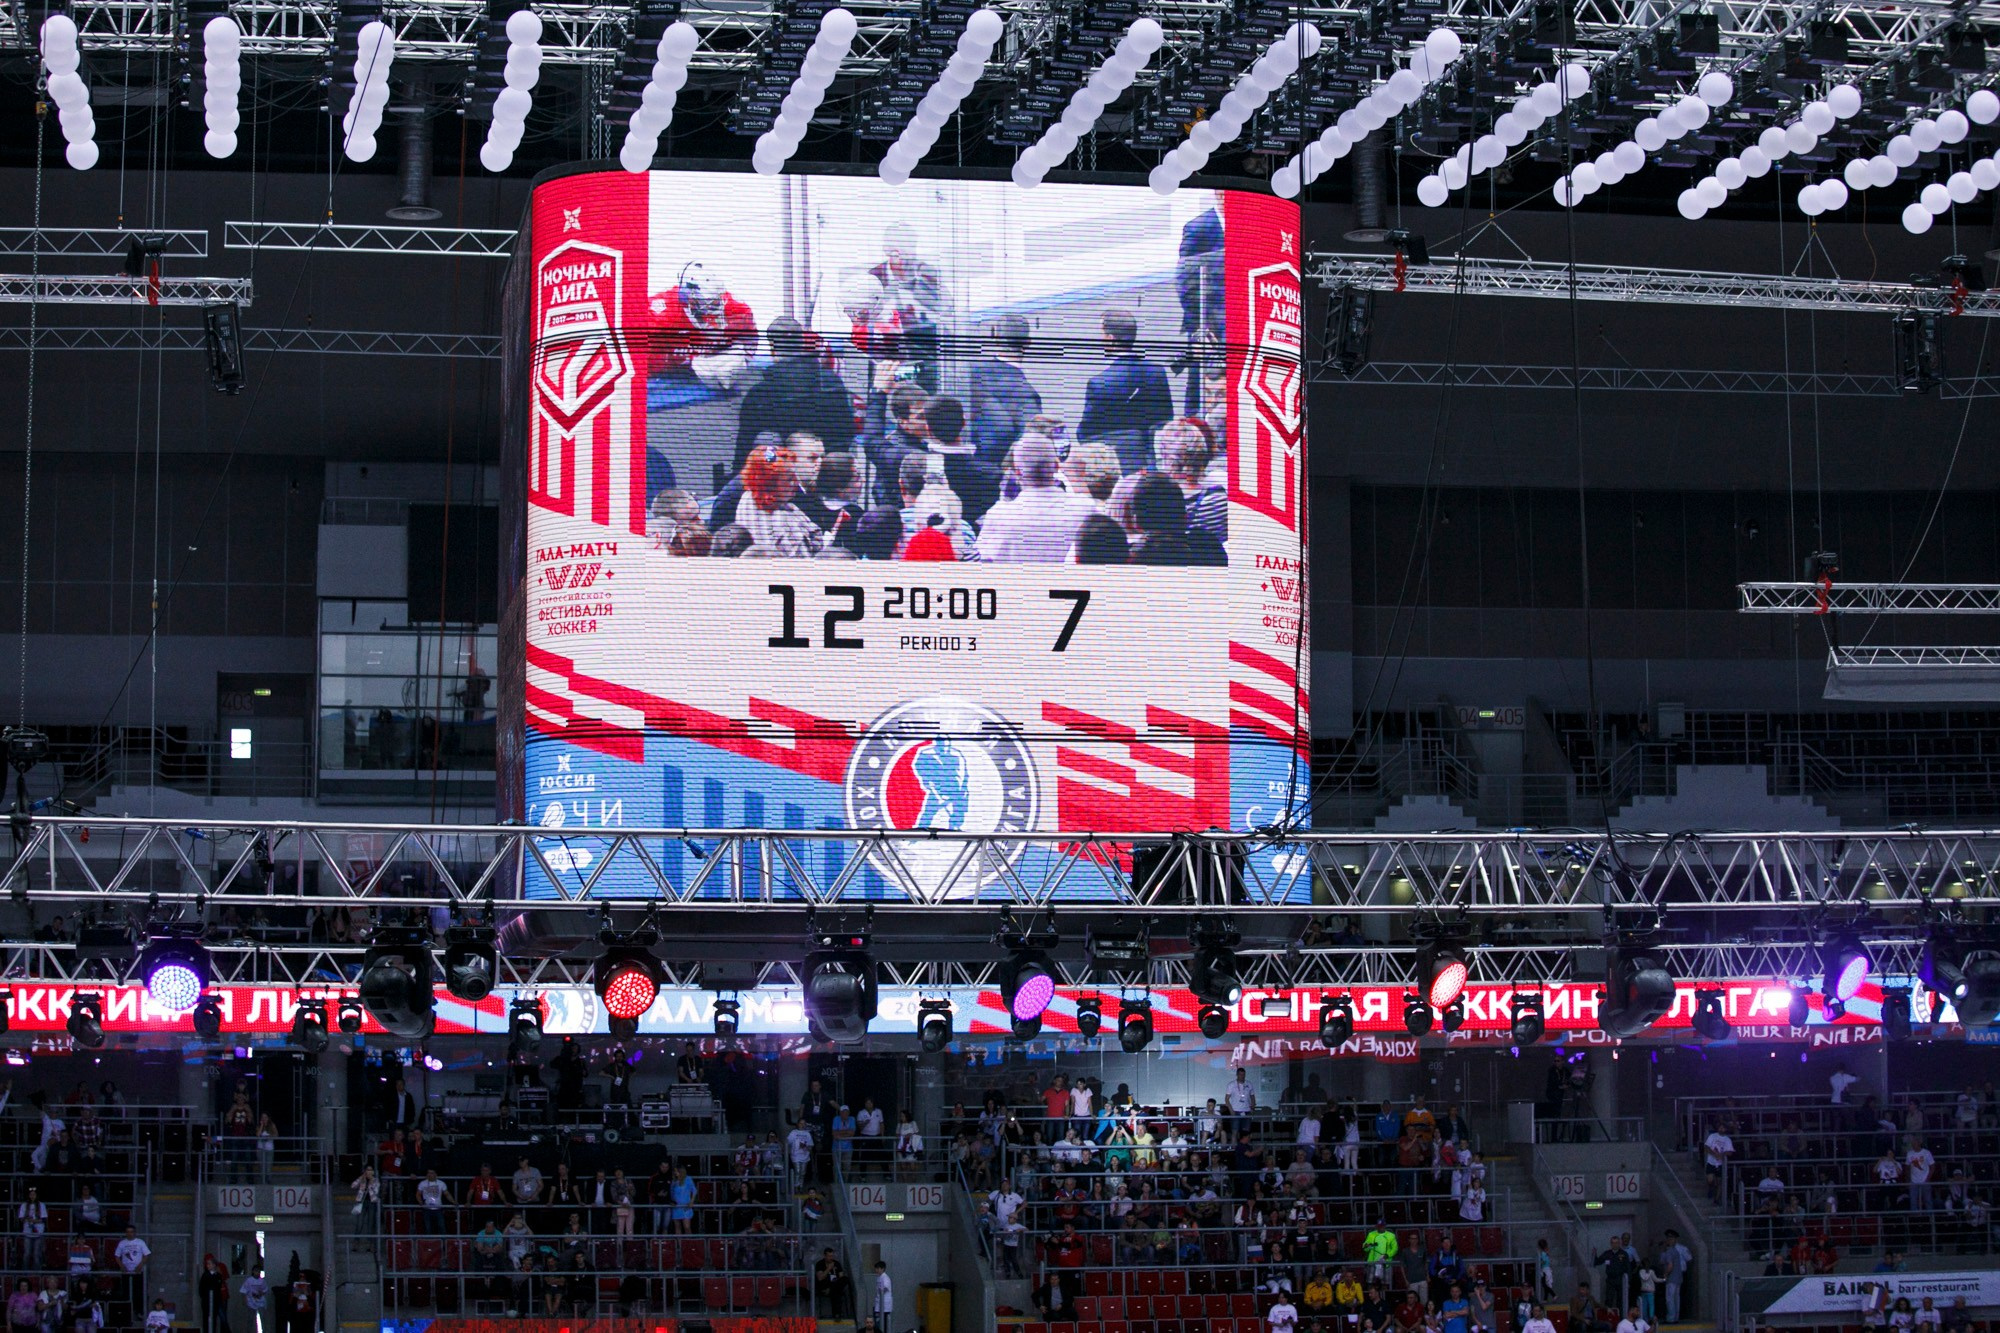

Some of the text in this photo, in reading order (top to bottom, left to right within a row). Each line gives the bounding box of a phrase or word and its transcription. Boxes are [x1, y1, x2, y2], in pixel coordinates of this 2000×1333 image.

[543, 261, 612, 287] НОЧНАЯ
[550, 281, 599, 305] ЛИГА
[536, 542, 617, 563] ГАЛА-МАТЧ
[538, 603, 613, 621] ФЕСТИВАЛЯ
[884, 587, 997, 620] 20:00
[769, 585, 864, 649] 12
[1049, 590, 1091, 652] 7
[547, 619, 597, 636] ХОККЕЯ
[901, 636, 977, 651] PERIOD 3
[1459, 708, 1478, 726] 04
[1495, 708, 1524, 726] 405
[540, 774, 595, 789] РОССИЯ
[1607, 1175, 1638, 1194] 106
[221, 1188, 254, 1208] 103
[276, 1188, 310, 1208] 104
[852, 1186, 885, 1206] 104
[909, 1186, 942, 1206] 105
[1823, 1281, 1893, 1296] BAIKL
